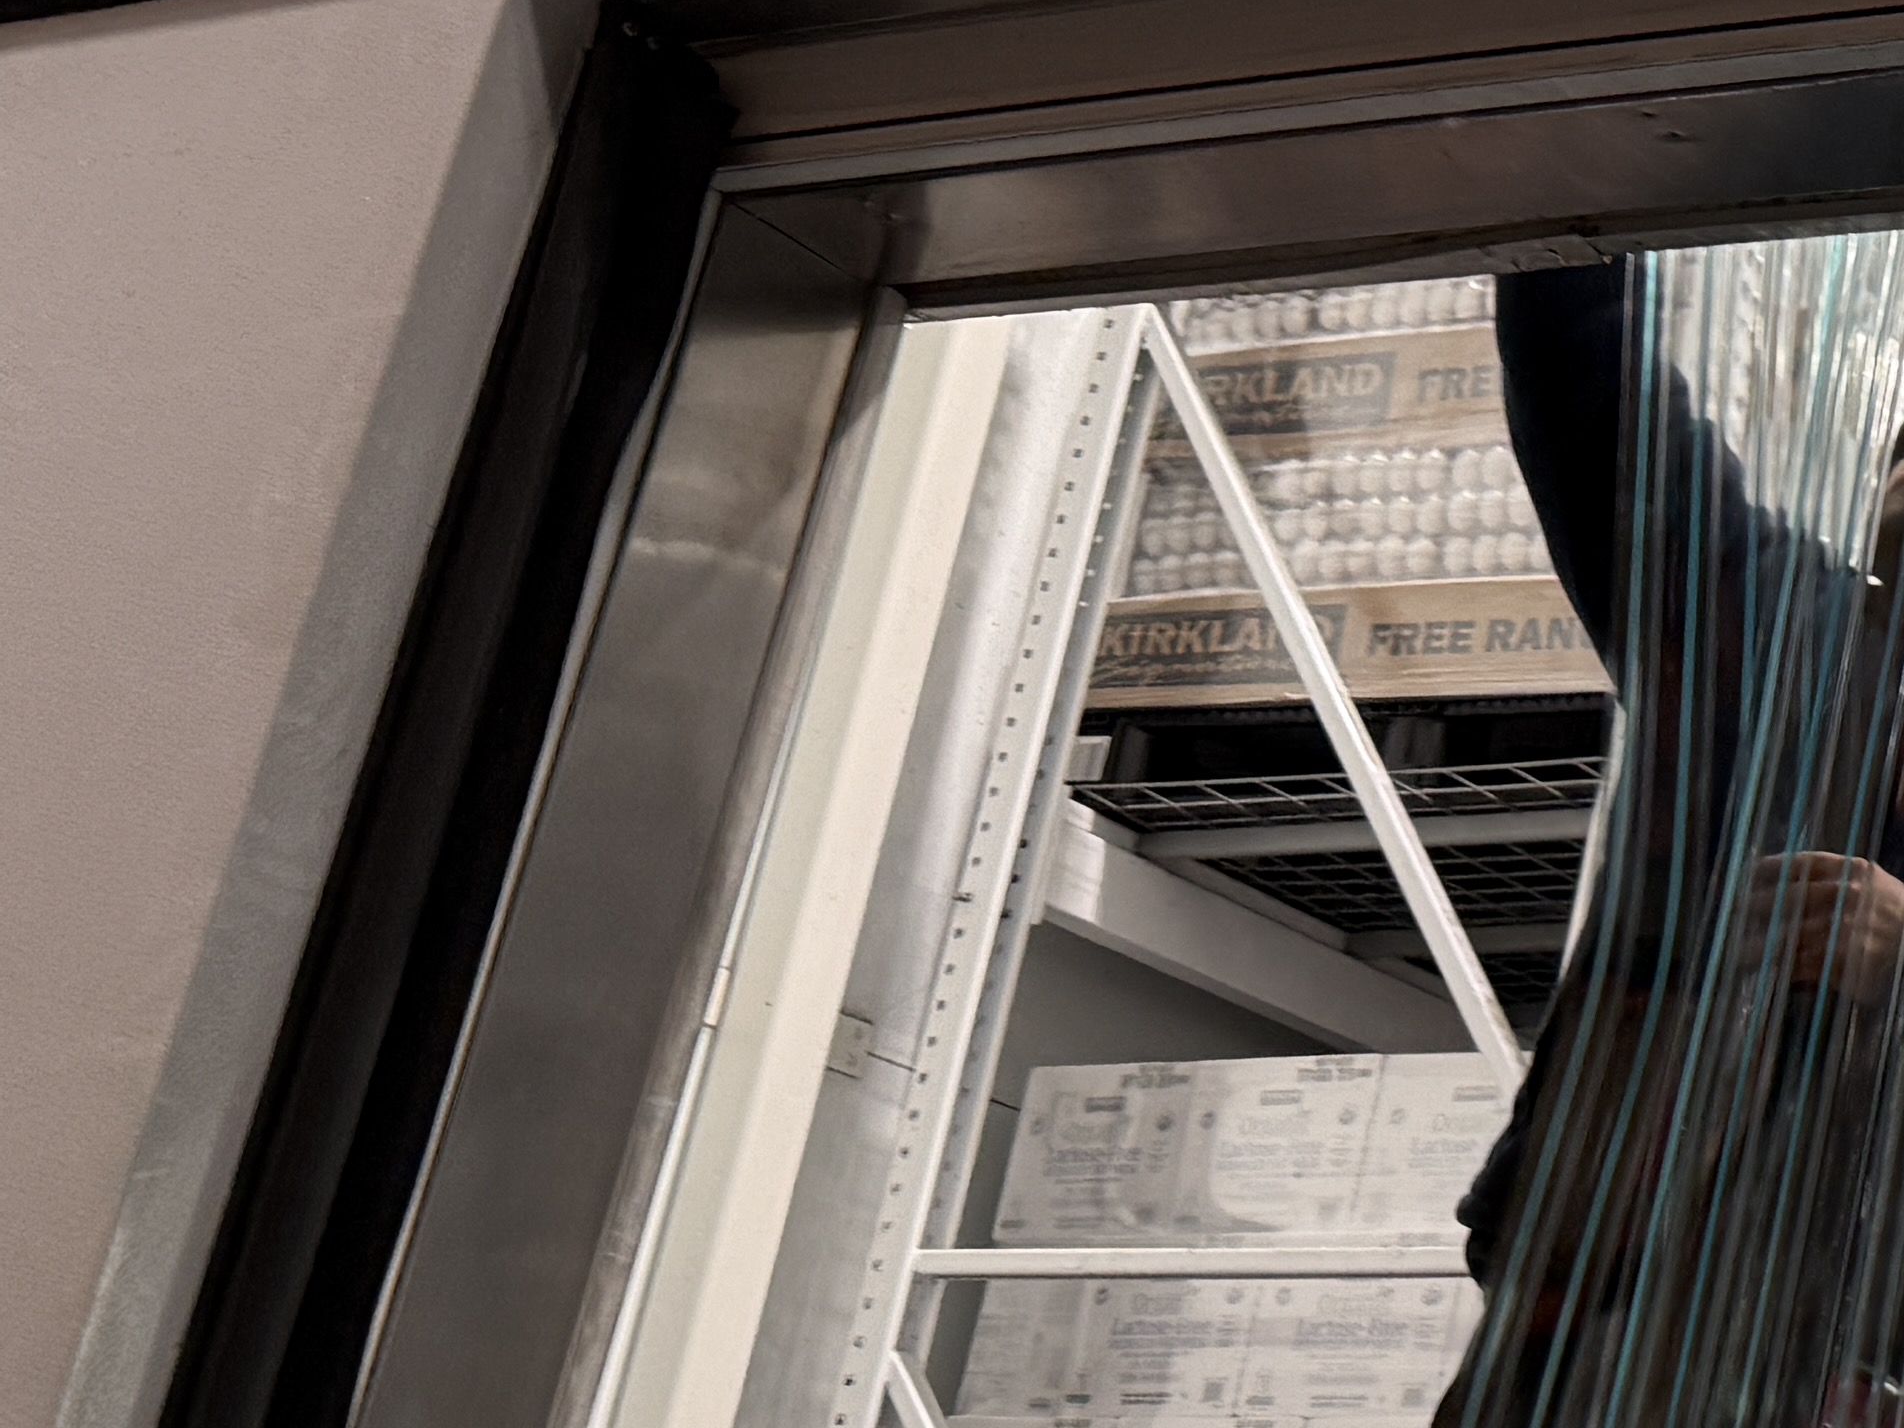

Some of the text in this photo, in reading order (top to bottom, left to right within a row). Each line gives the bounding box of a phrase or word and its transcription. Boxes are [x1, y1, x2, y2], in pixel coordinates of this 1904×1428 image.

[1203, 361, 1502, 407] RKLAND FRE
[1368, 619, 1476, 656] FREE
[1485, 617, 1593, 653] RAN
